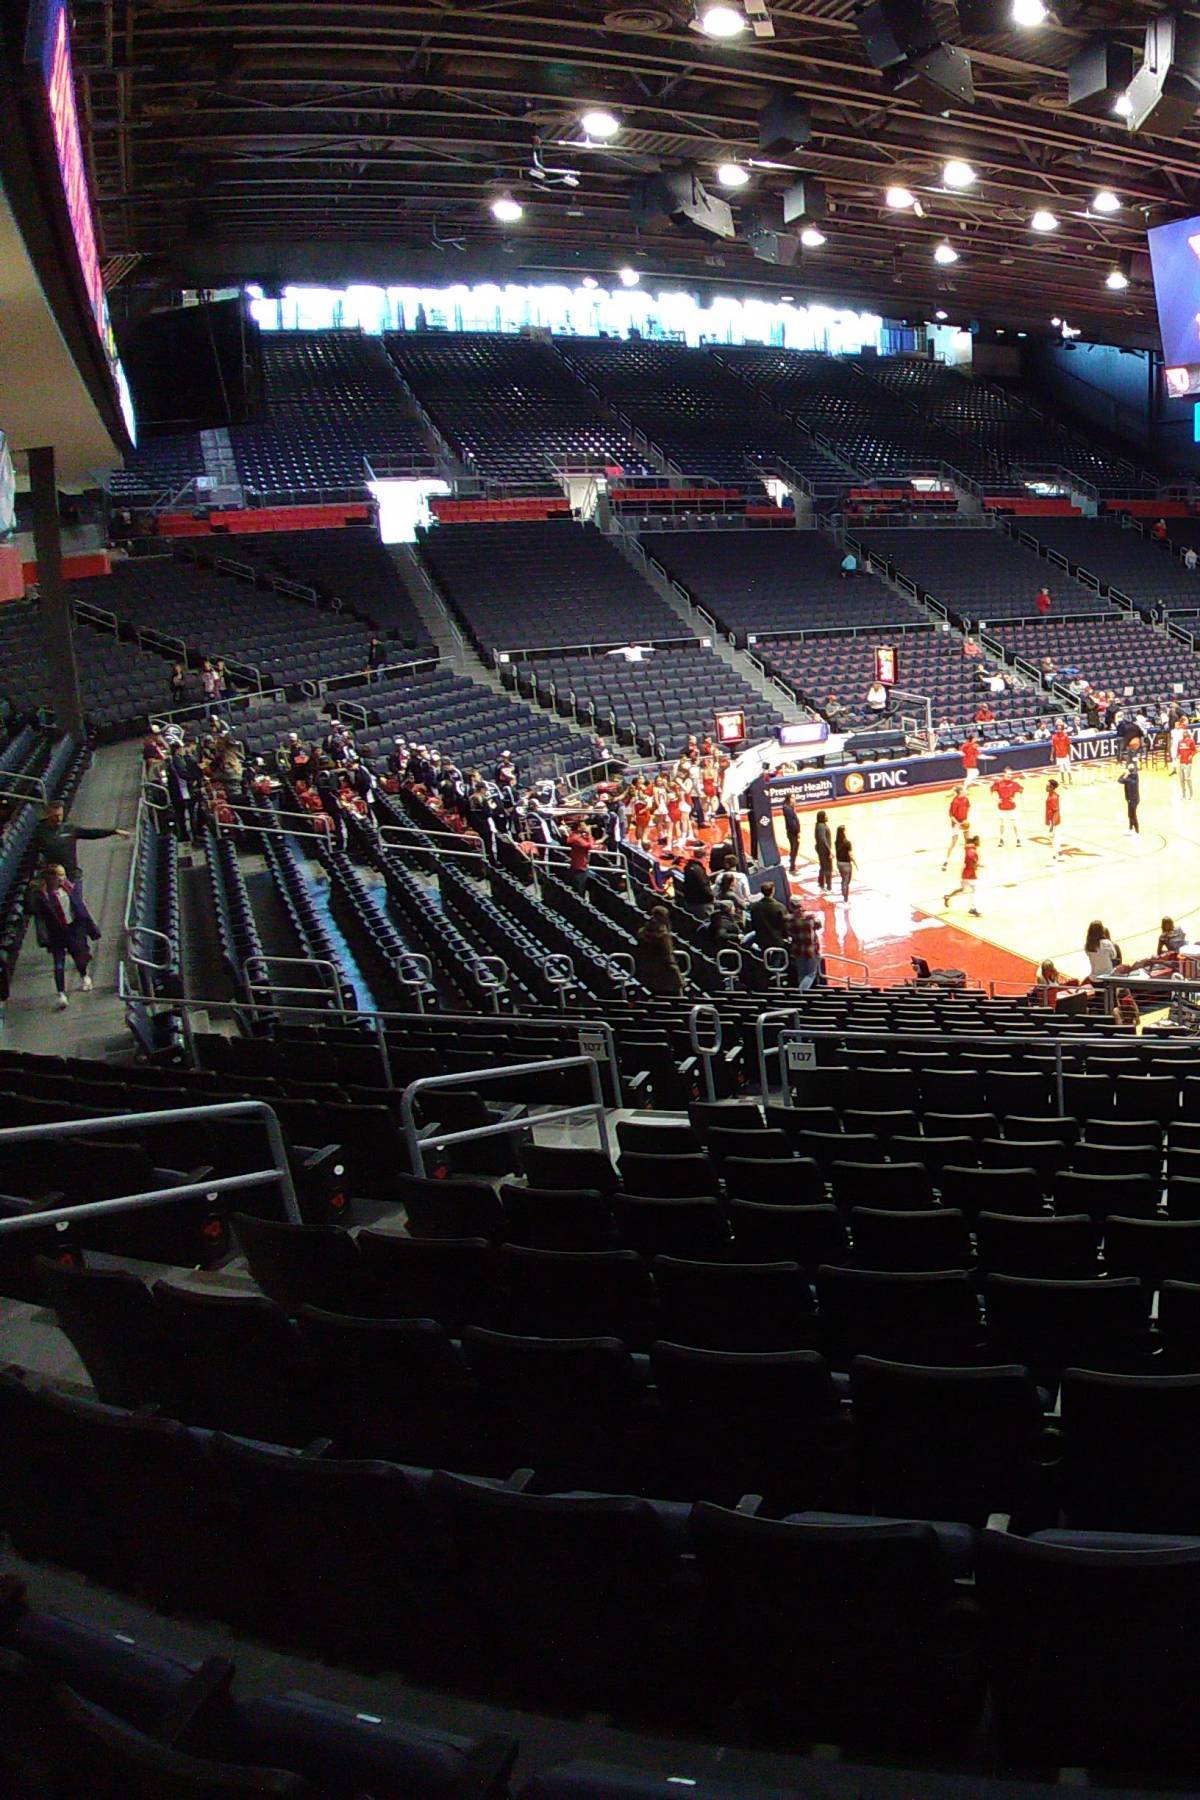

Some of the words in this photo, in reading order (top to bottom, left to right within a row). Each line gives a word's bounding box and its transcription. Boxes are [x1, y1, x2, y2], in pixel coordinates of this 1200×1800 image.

[869, 769, 908, 789] PNC
[770, 785, 802, 796] Premier
[804, 780, 832, 791] Health
[583, 1042, 602, 1053] 107
[792, 1051, 811, 1062] 107
